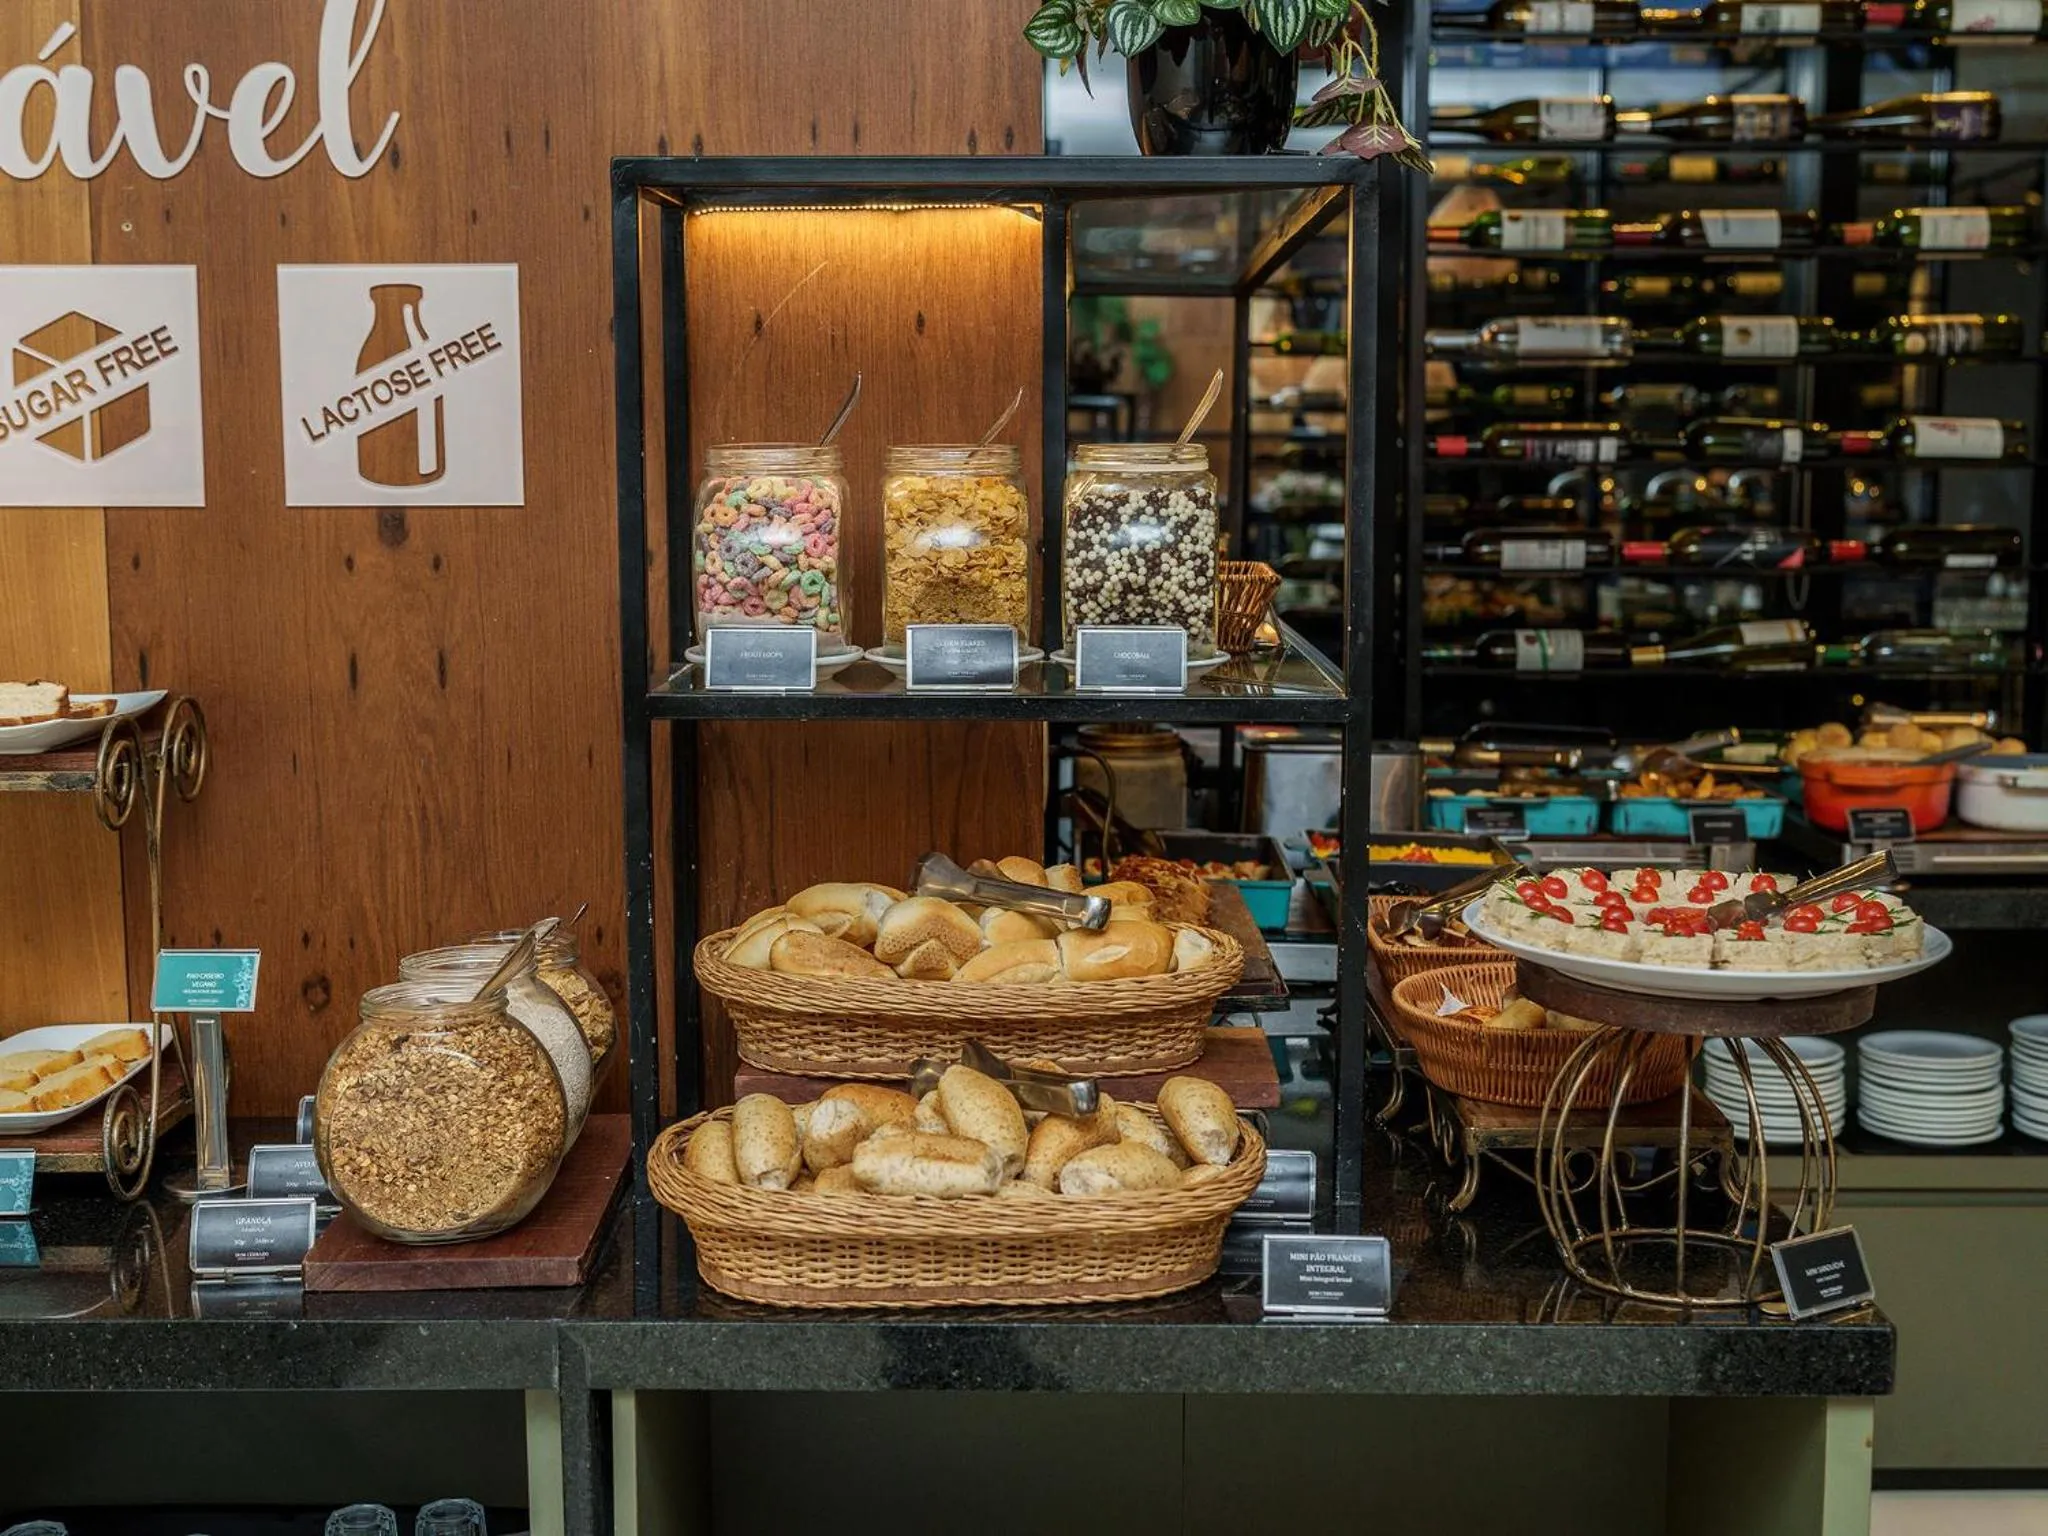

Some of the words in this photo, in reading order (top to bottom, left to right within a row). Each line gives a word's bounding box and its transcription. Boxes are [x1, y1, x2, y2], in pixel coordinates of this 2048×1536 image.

[0, 0, 400, 179] ável
[95, 324, 179, 387] FREE
[302, 357, 431, 443] LACTOSE
[429, 322, 502, 385] FREE
[235, 1216, 272, 1225] GRANOLA
[1290, 1252, 1309, 1261] MINI
[1310, 1251, 1326, 1262] PÃO
[1306, 1264, 1346, 1274] INTEGRAL
